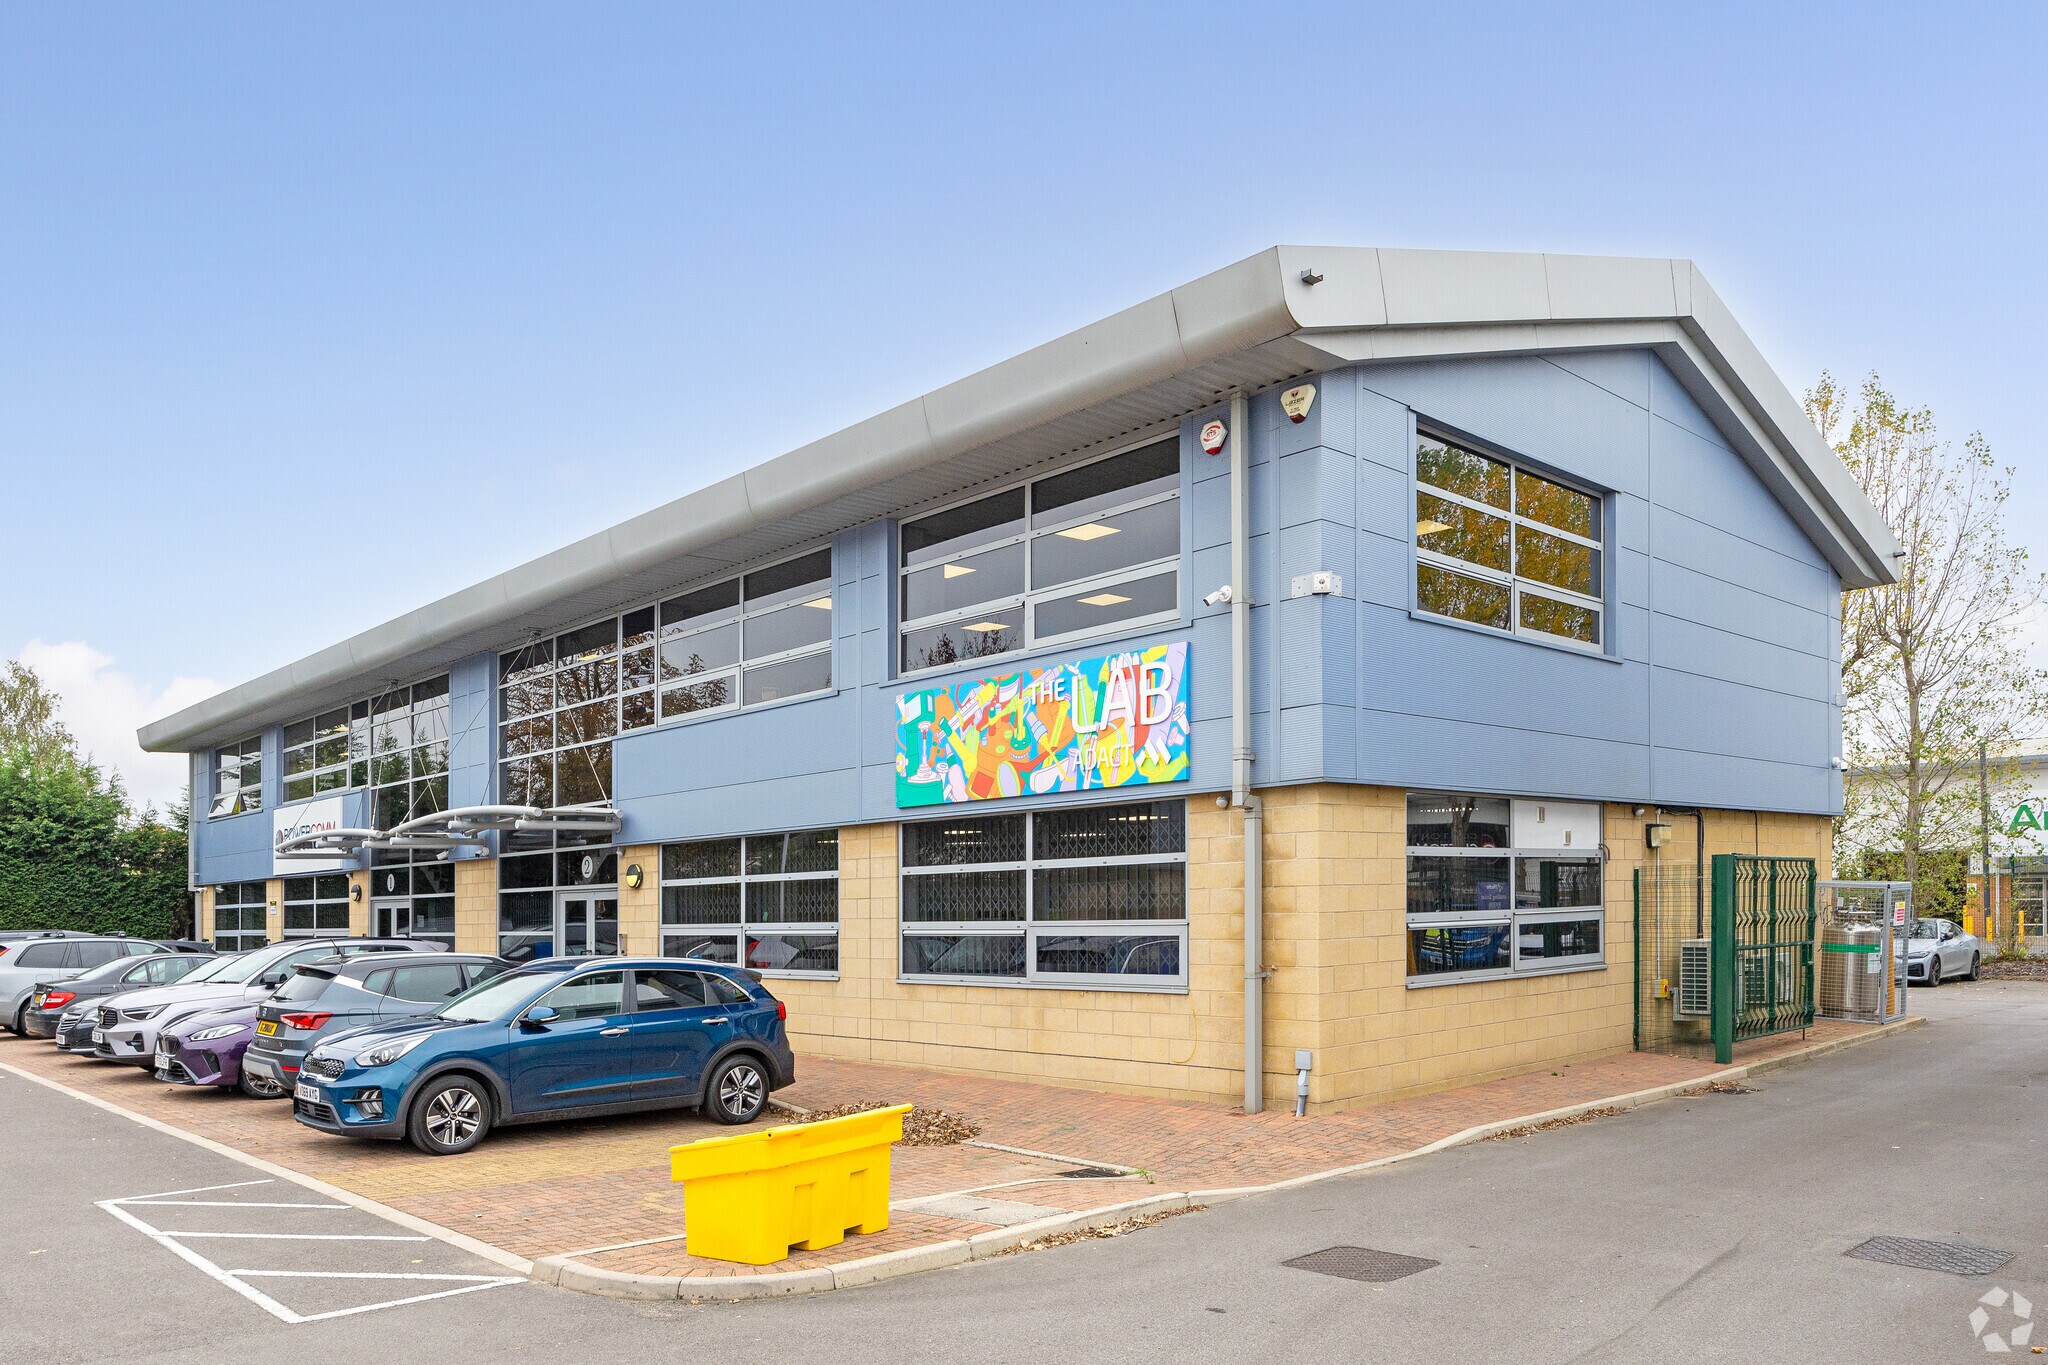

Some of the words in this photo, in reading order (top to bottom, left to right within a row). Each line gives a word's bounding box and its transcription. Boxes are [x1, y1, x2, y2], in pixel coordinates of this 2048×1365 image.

[1031, 678, 1065, 705] THE
[1072, 661, 1173, 733] LAB
[1072, 743, 1134, 773] ADACT
[283, 820, 336, 840] POWERCOMM
[584, 859, 590, 875] 2
